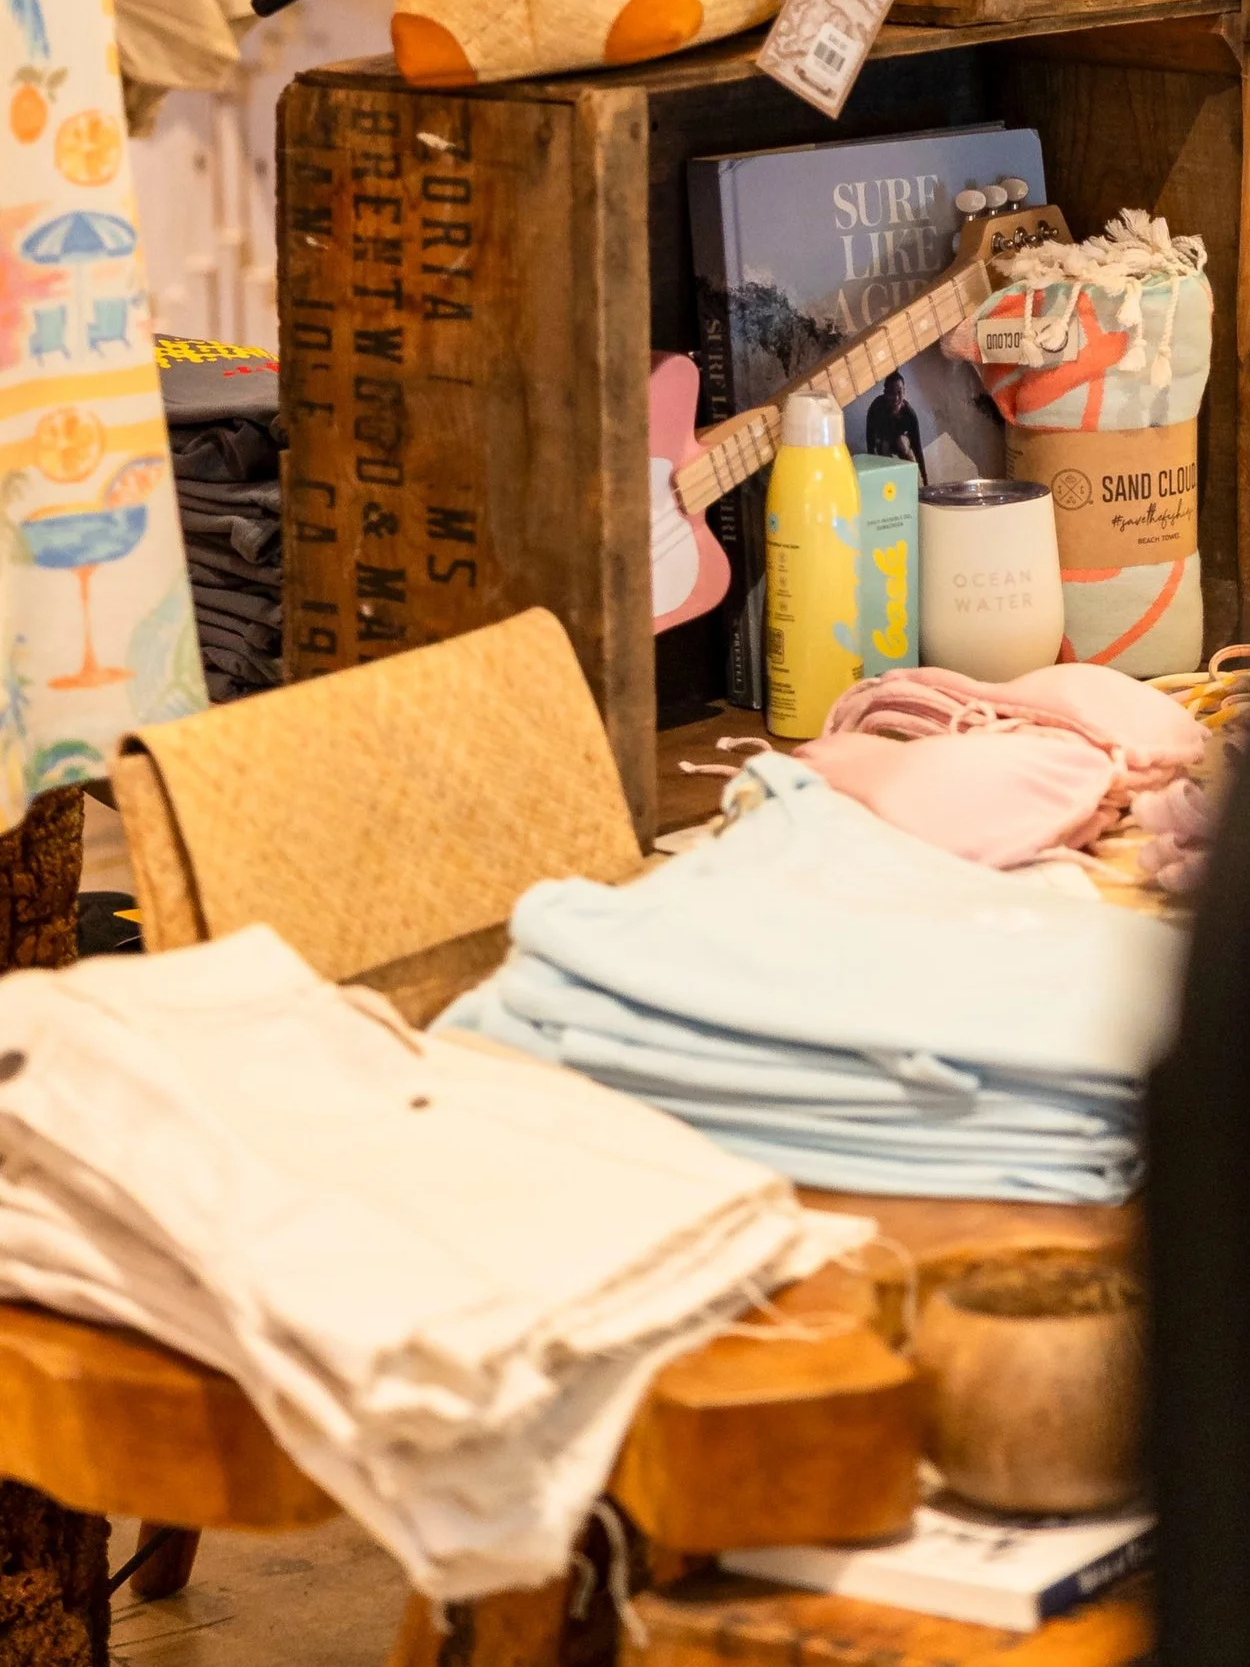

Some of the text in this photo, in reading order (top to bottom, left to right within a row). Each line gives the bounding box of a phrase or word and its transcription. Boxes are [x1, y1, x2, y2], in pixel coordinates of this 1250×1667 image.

[833, 175, 940, 230] SURF
[840, 225, 942, 282] LIKE
[1101, 472, 1151, 503] SAND
[362, 502, 399, 540] &
[1137, 536, 1160, 545] BEACH
[953, 567, 1032, 589] OCEAN
[355, 560, 408, 665] MA
[954, 592, 1033, 613] WATER
[296, 599, 339, 675] 19
